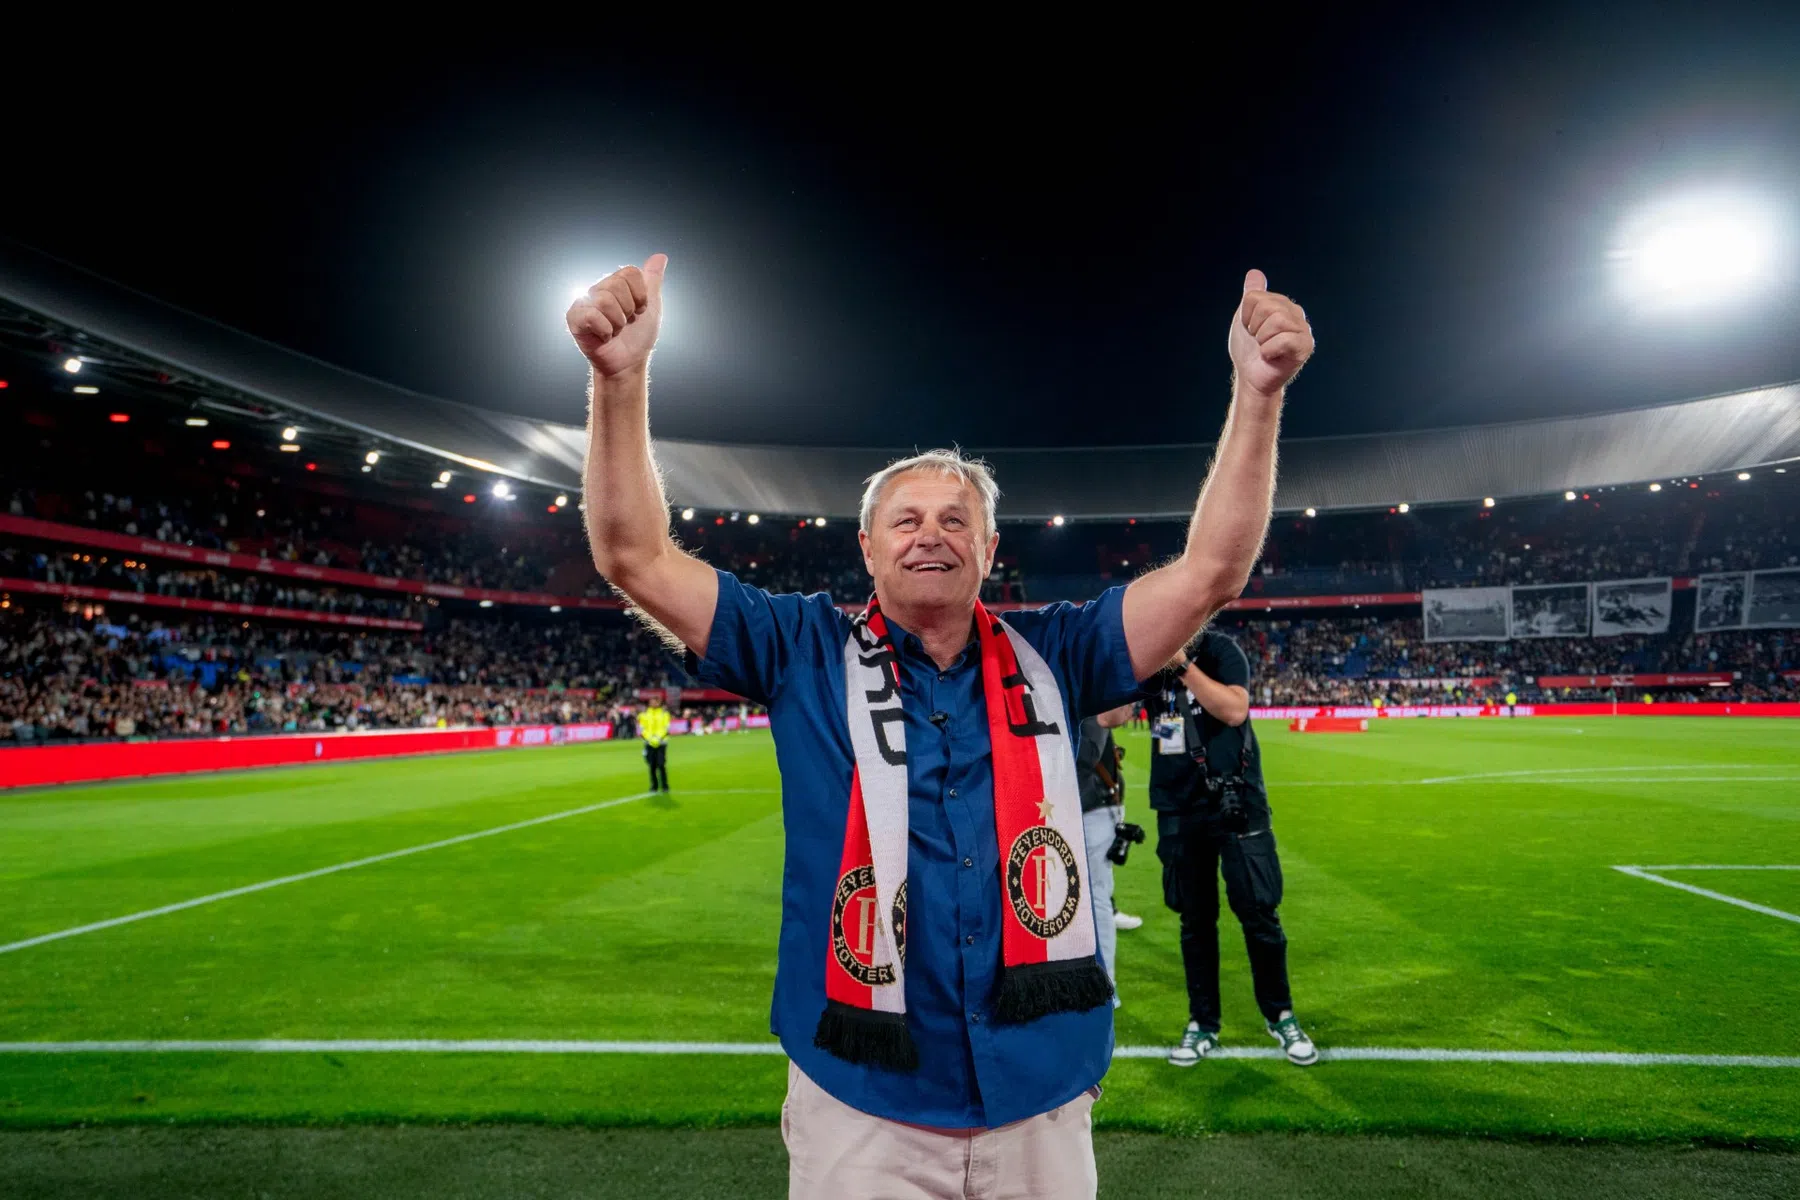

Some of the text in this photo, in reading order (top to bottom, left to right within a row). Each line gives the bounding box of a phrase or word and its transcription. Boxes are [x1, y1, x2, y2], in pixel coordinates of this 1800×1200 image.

[1012, 829, 1074, 868] FEYENOORD
[836, 869, 876, 906] FEYE
[1014, 895, 1077, 935] ROTTERDAM
